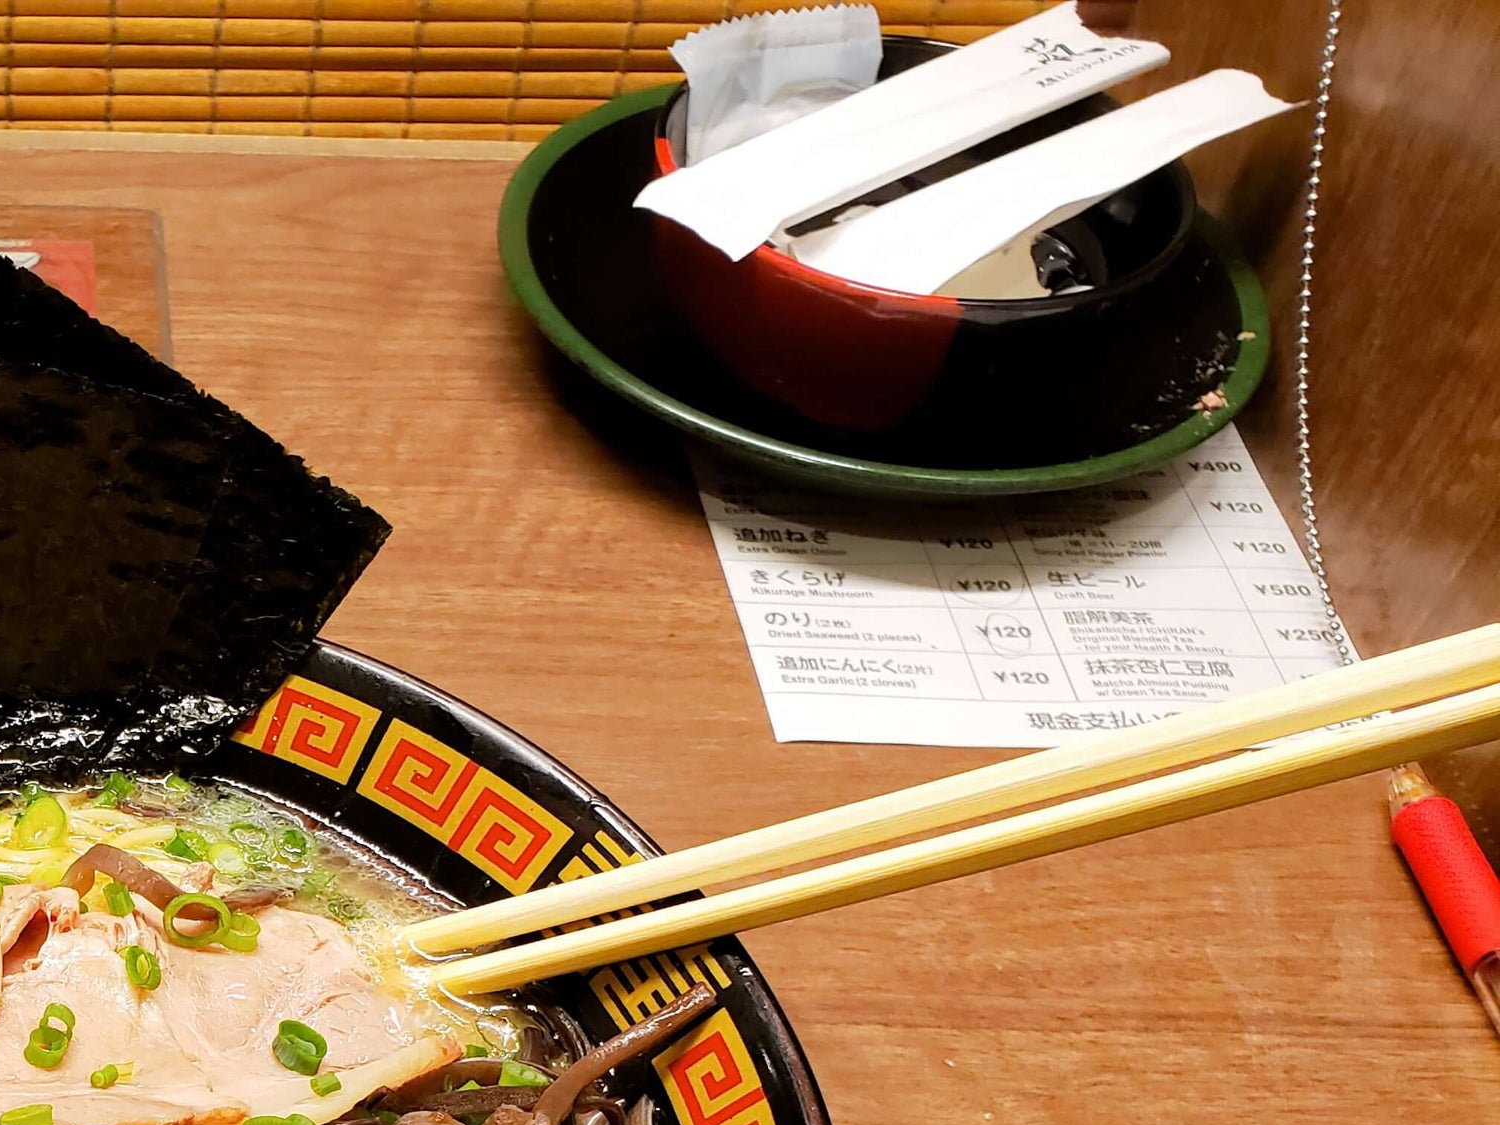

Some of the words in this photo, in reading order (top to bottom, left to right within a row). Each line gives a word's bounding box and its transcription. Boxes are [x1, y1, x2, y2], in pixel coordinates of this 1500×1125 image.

[1188, 460, 1242, 473] ¥490
[1209, 501, 1263, 514] ¥120
[732, 527, 830, 545] 追加ねぎ
[939, 538, 994, 549] ¥120
[1232, 541, 1286, 555] ¥120
[750, 568, 846, 587] きくらげ
[1047, 571, 1146, 589] 生ビール
[751, 586, 804, 597] Kikurage
[809, 588, 874, 598] Mushroom
[957, 580, 1012, 591] ¥120
[1254, 583, 1311, 597] ¥580
[768, 629, 801, 639] Dried
[805, 630, 859, 640] Seaweed
[878, 633, 922, 643] pieces)
[975, 625, 1032, 638] ¥120
[1085, 658, 1234, 678] 抹茶杏仁豆腐
[781, 674, 815, 684] Extra
[993, 670, 1050, 685] ¥120
